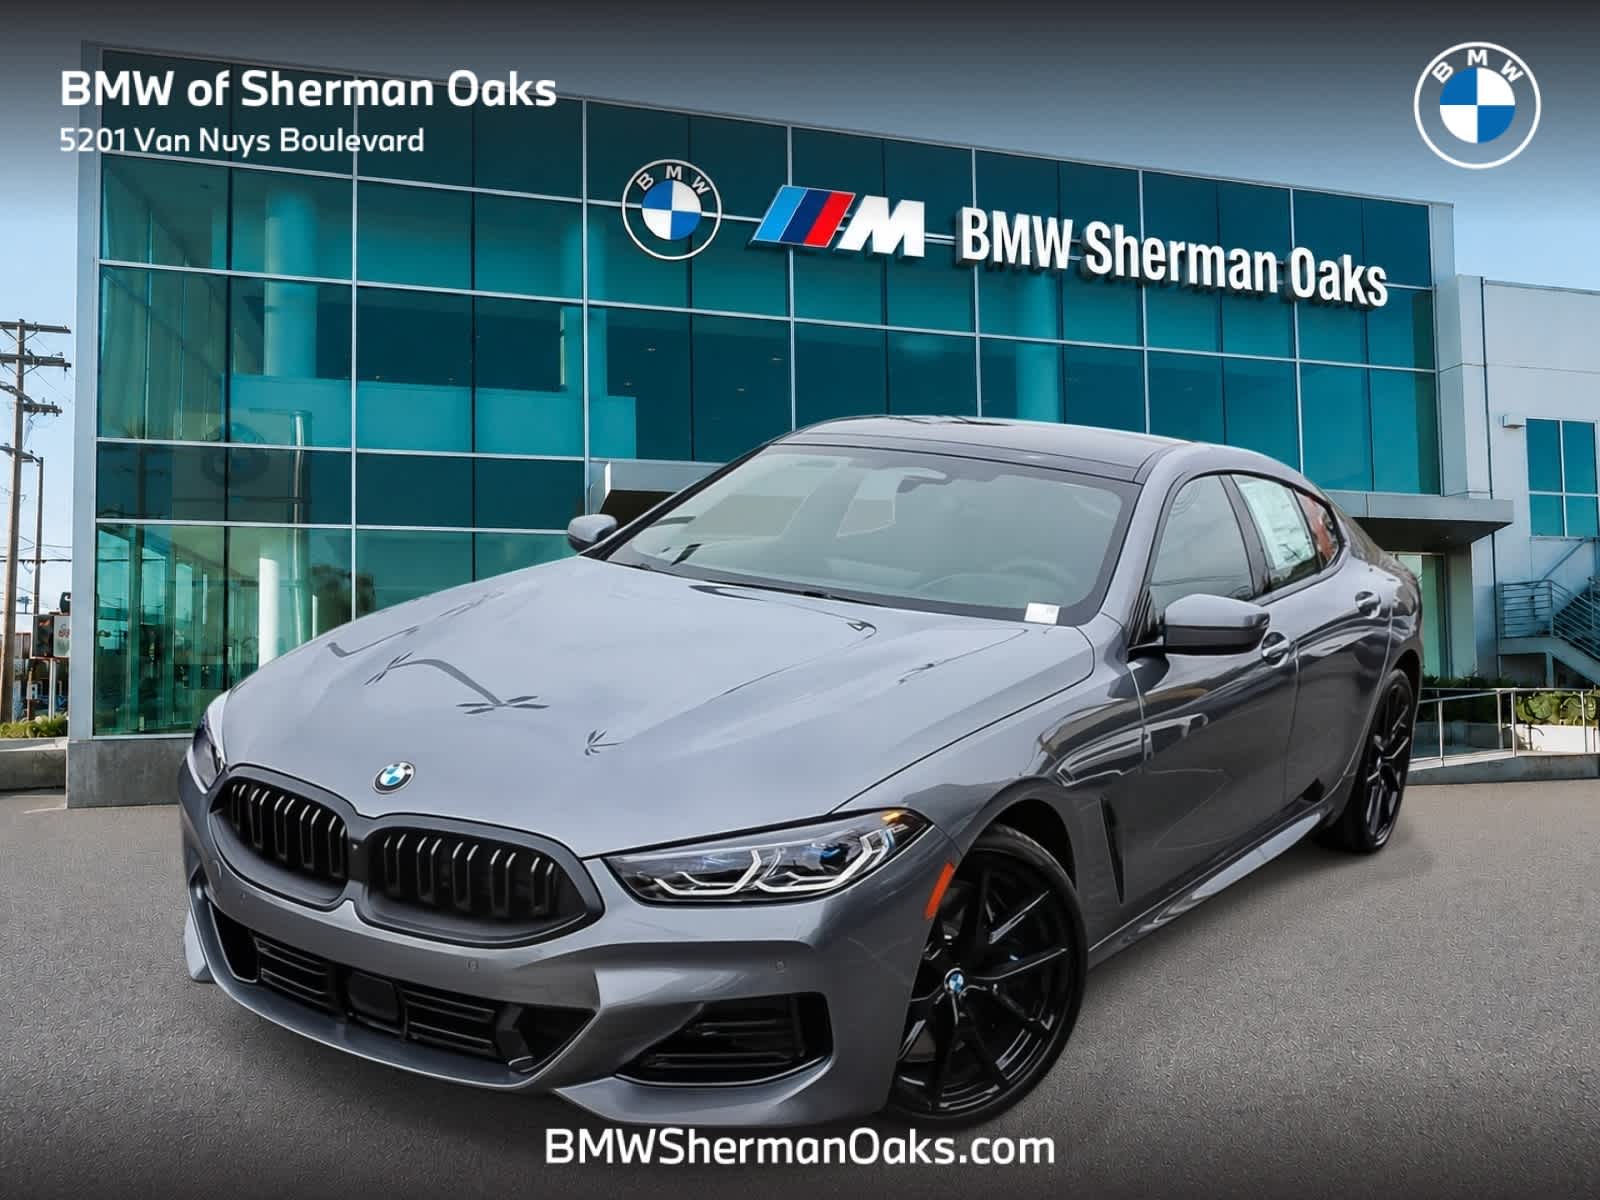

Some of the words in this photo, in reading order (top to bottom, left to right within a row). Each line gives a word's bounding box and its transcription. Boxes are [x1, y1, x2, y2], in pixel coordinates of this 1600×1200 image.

[834, 194, 925, 258] M
[957, 206, 1074, 270] BMW
[1083, 220, 1278, 294] Sherman
[1286, 246, 1389, 308] Oaks
